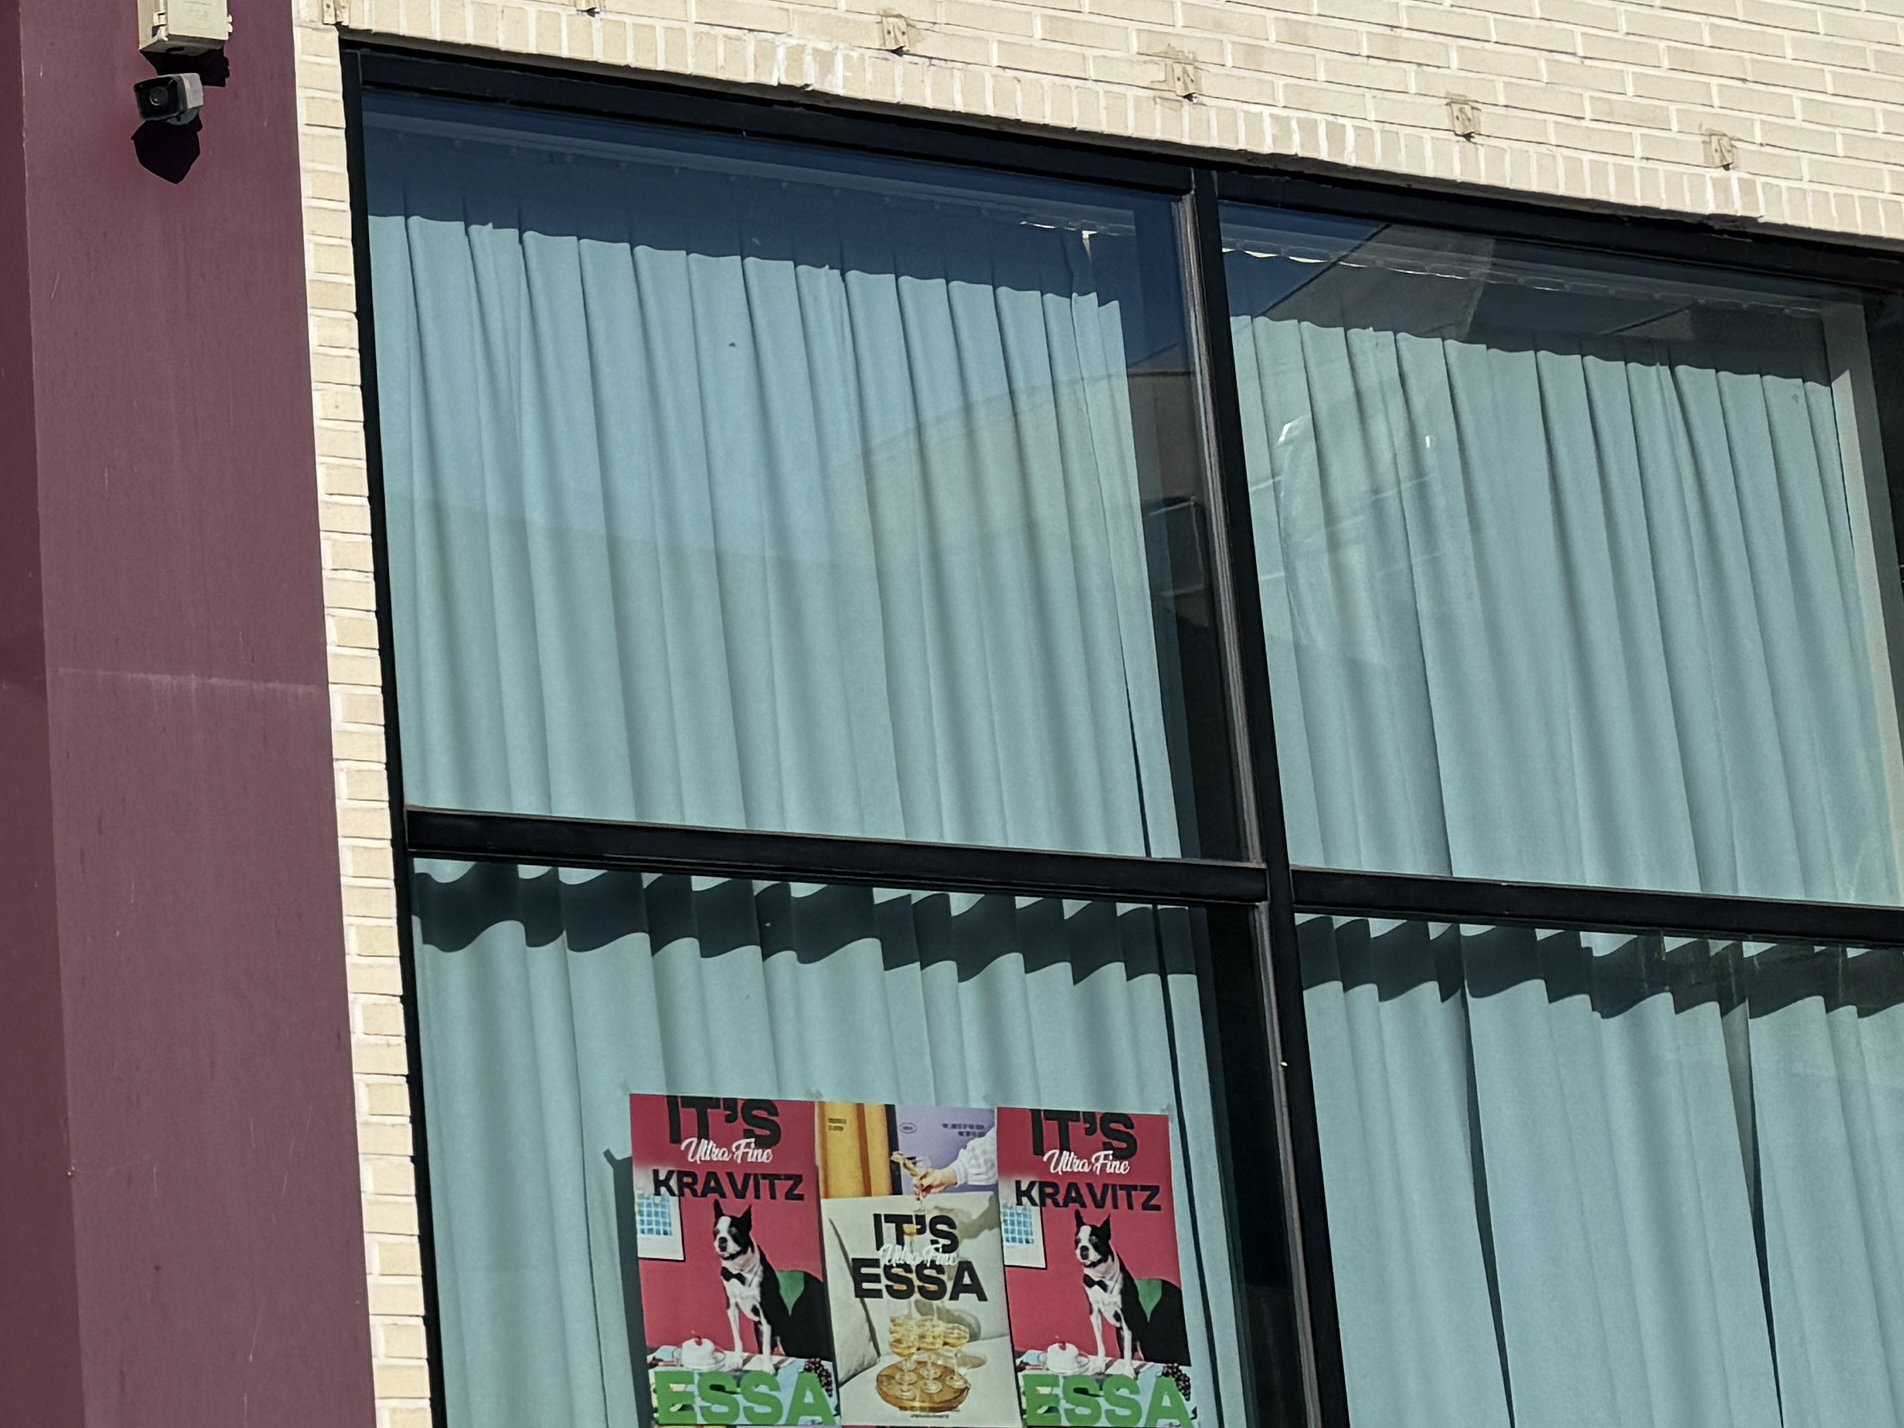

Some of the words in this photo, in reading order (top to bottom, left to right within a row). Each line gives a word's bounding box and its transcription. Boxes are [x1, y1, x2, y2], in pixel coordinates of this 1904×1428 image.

[666, 1095, 782, 1149] IT'S
[1029, 1109, 1138, 1160] IT'S
[681, 1137, 732, 1164] Ultra
[732, 1138, 773, 1164] Fine
[1043, 1149, 1091, 1175] Ultra
[1091, 1150, 1131, 1174] Fine
[652, 1168, 805, 1201] KRAVITZ
[1015, 1180, 1162, 1211] KRAVITZ
[873, 1213, 960, 1254] IT'S
[851, 1257, 989, 1302] ESSA
[654, 1369, 837, 1426] ESSA
[1022, 1373, 1195, 1428] ESSA
